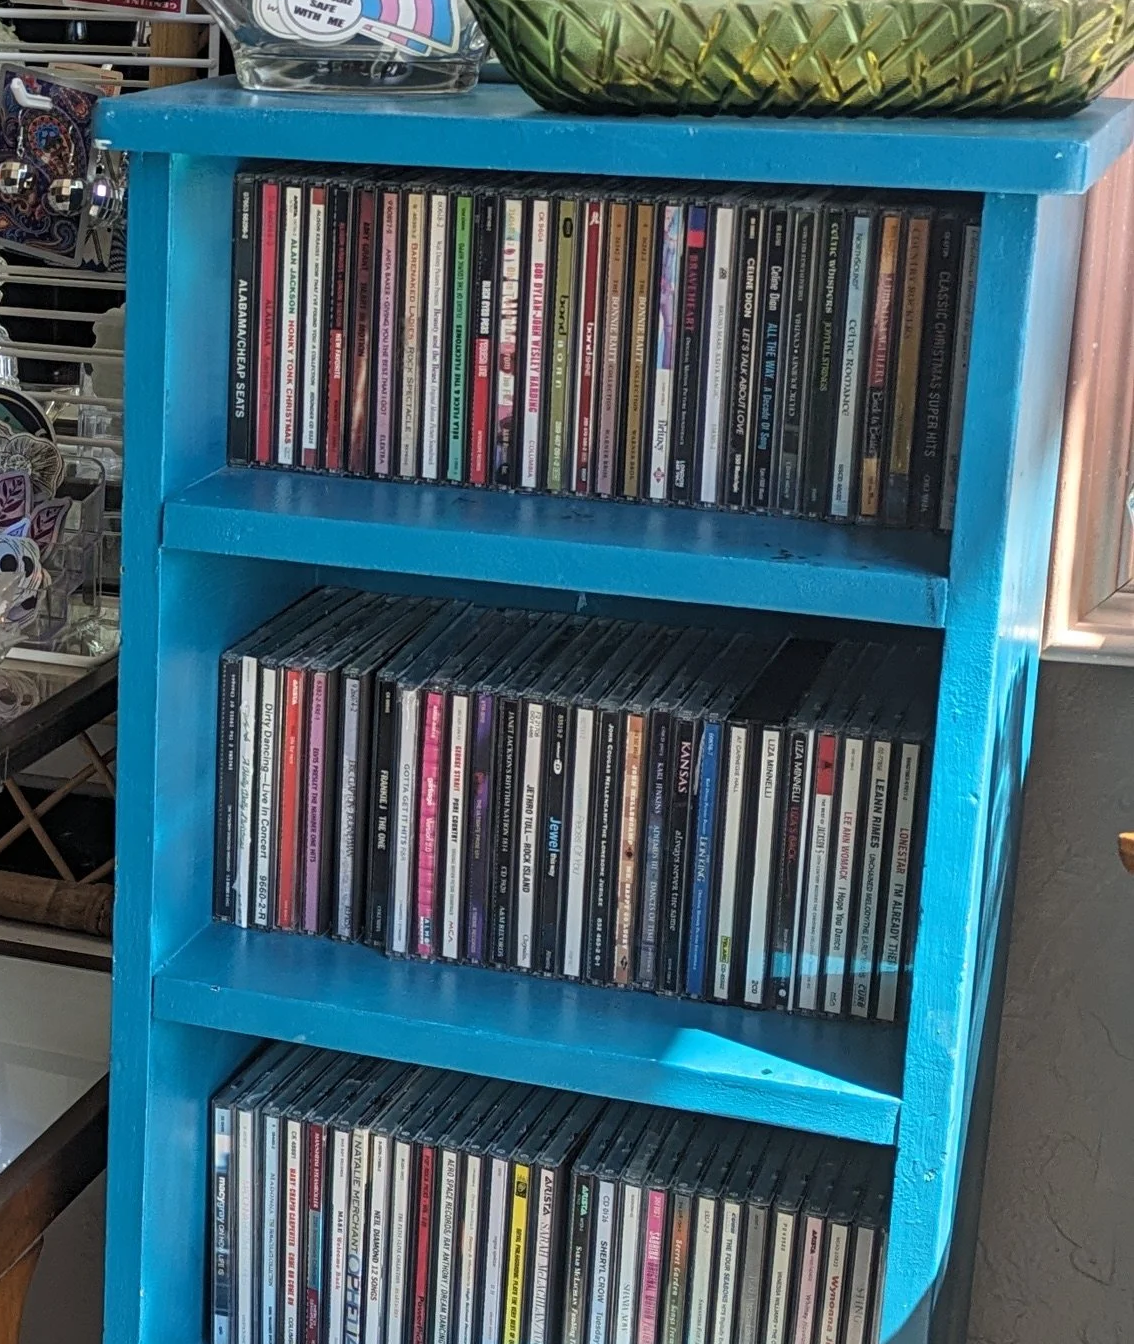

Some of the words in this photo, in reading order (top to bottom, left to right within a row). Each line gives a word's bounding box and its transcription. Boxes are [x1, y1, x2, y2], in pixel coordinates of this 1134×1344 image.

[293, 5, 323, 22] WITH
[327, 16, 347, 28] ME
[309, 0, 338, 14] SAFE
[289, 238, 298, 263] ALAN
[408, 242, 419, 302] BARENAKED
[534, 263, 544, 279] BOB
[744, 258, 755, 293] CELINE
[769, 265, 782, 290] Celine
[287, 266, 297, 315] JACKSON
[768, 292, 781, 311] Dion
[935, 271, 950, 319] CLASSIC
[609, 296, 619, 333] BONNIE
[636, 296, 646, 333] BONNIE
[743, 294, 753, 318] DION
[236, 279, 248, 379] ALABAMA/CHEAP
[264, 299, 274, 347] ALABAMA
[407, 304, 416, 341] LADIES
[765, 323, 777, 339] ALL
[286, 320, 295, 355] HONKY
[635, 335, 645, 364] RAITT
[764, 340, 776, 358] THE
[406, 346, 415, 373] ROCK
[530, 340, 541, 372] WESLEY
[739, 352, 749, 375] TALK
[930, 322, 946, 389] CHRISTMAS
[285, 358, 294, 385] TONK
[235, 382, 246, 418] SEATS
[404, 377, 414, 433] SPECTACLE
[529, 375, 540, 413] HARDING
[738, 376, 748, 407] ABOUT
[284, 388, 293, 444] CHRISTMAS
[736, 408, 746, 435] LOVE
[927, 392, 941, 429] SUPER
[758, 432, 770, 449] Song
[924, 432, 938, 457] HITS
[263, 703, 274, 727] Dirty
[766, 739, 775, 757] LIZA
[793, 739, 804, 760] LIZA
[402, 764, 411, 791] GOTTA
[677, 741, 690, 793] KANSAS
[764, 759, 774, 798] MINNELLI
[379, 770, 388, 802] FRANKIE
[503, 775, 511, 805] RHYTHM
[791, 762, 803, 803] MINNELLI
[872, 778, 885, 813] LEANN
[401, 795, 409, 813] GET
[524, 784, 535, 812] JETHRO
[378, 816, 387, 830] THE
[502, 807, 510, 836] NATION
[523, 814, 534, 834] TULL
[842, 812, 853, 825] LEE
[870, 816, 883, 849] RIMES
[258, 819, 270, 858] Concert
[377, 832, 387, 849] ONE
[400, 825, 408, 845] HITS
[548, 816, 562, 851] Jewel
[840, 826, 852, 844] ANN
[522, 842, 533, 862] ROCK
[838, 845, 851, 881] WOMACK
[894, 828, 909, 874] LONESTAR
[521, 864, 532, 893] ISLAND
[891, 883, 904, 898] I'M
[887, 900, 902, 940] ALREADY
[751, 980, 759, 994] 2CD
[351, 1140, 362, 1187] NATALIE
[445, 1159, 455, 1177] AERO
[444, 1178, 454, 1199] SPACE
[350, 1189, 361, 1254] MERCHANT
[372, 1210, 381, 1226] NEIL
[371, 1228, 381, 1263] DIAMOND
[442, 1237, 451, 1251] RAY
[535, 1222, 550, 1257] SARAH
[370, 1265, 379, 1276] 12
[440, 1253, 450, 1284] ANTHONY
[597, 1240, 607, 1274] SHERYL
[369, 1278, 379, 1301] SONGS
[596, 1276, 607, 1303] CROW
[825, 1276, 839, 1332] Wynonna
[592, 1311, 603, 1343] Tuesday
